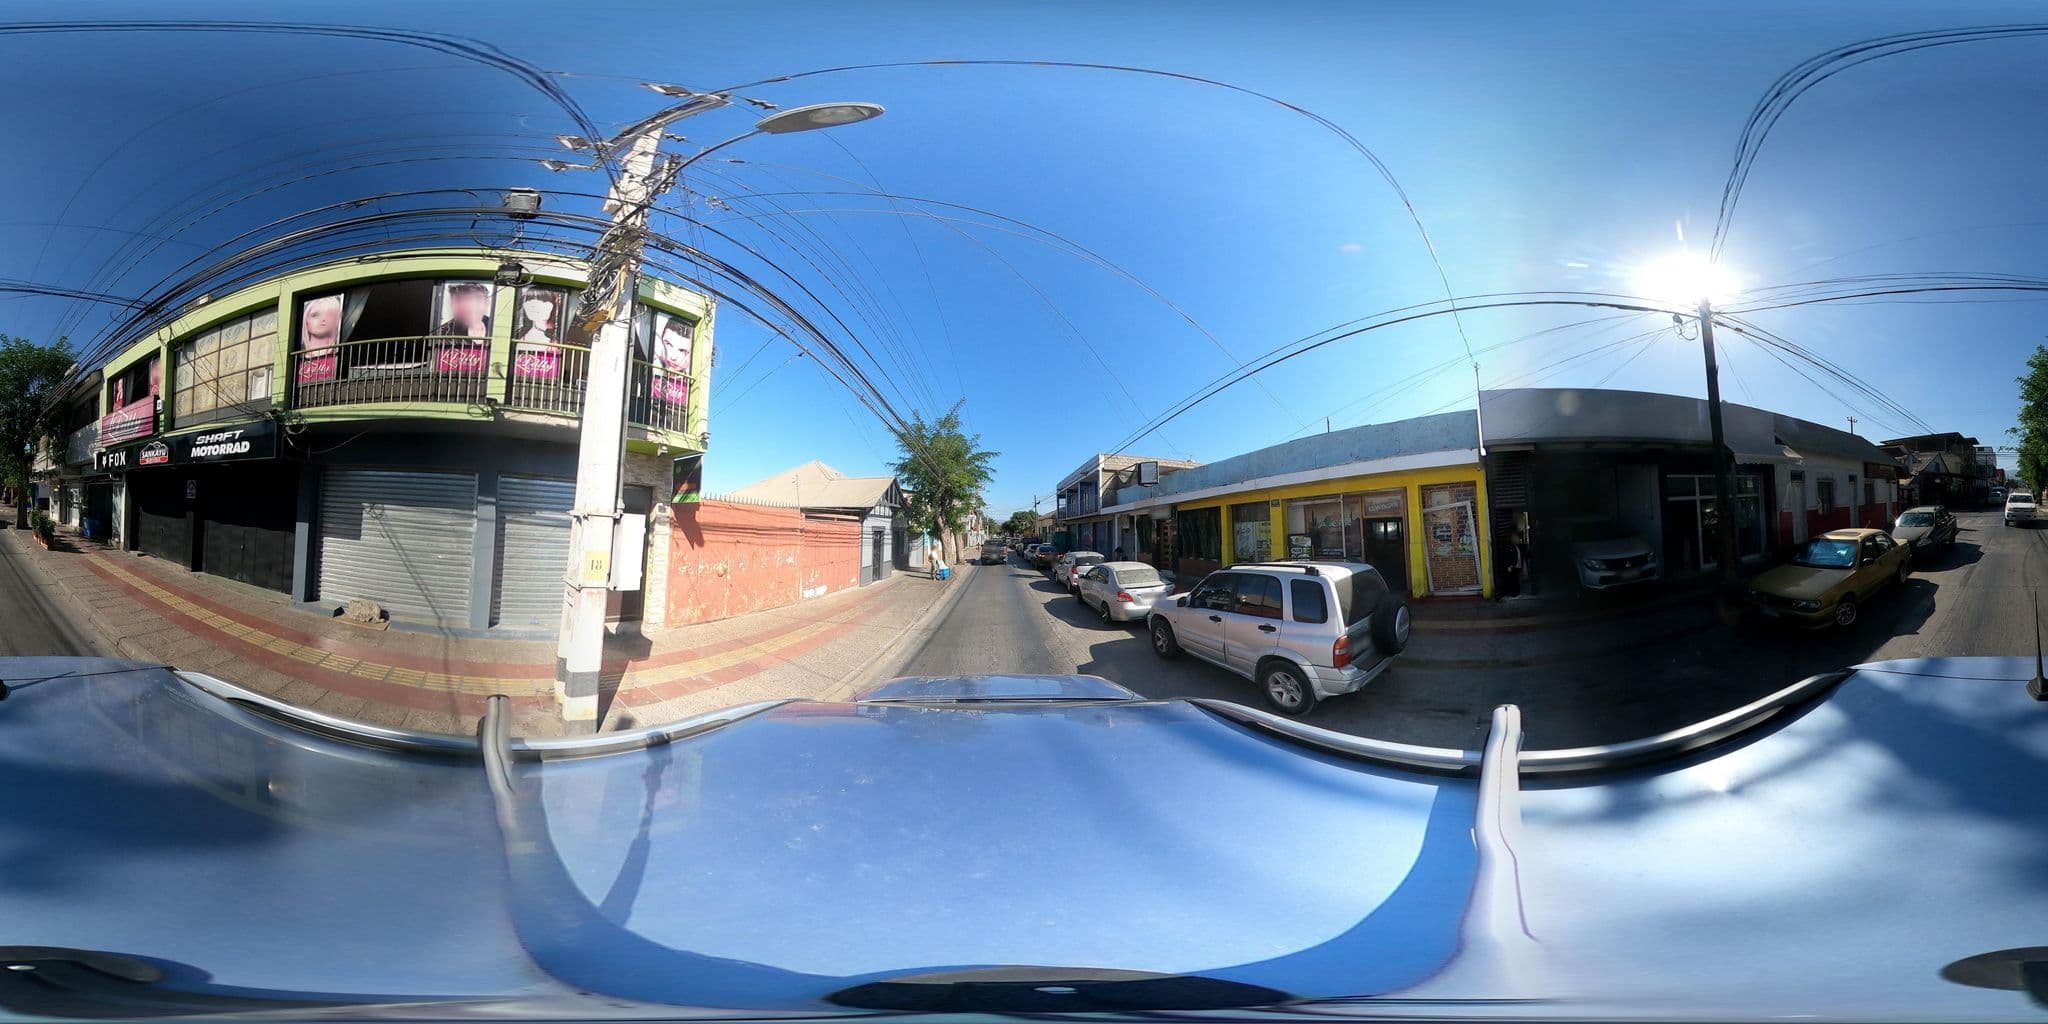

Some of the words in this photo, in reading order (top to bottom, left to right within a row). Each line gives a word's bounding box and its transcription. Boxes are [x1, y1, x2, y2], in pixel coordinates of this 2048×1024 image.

[195, 430, 244, 444] SHAFT
[191, 441, 250, 457] MOTORRAD
[109, 451, 126, 468] FOX
[591, 559, 602, 571] 18
